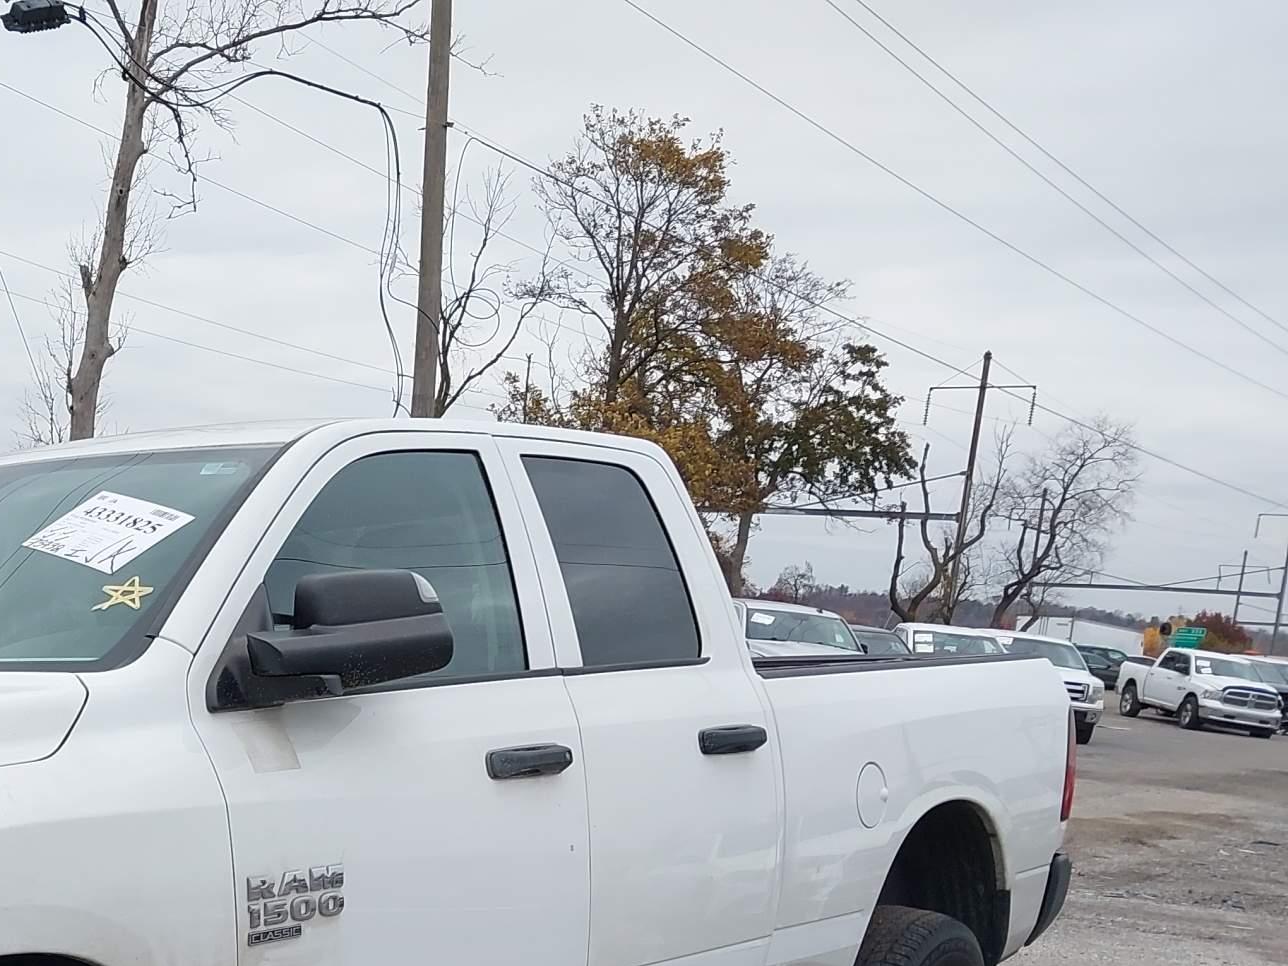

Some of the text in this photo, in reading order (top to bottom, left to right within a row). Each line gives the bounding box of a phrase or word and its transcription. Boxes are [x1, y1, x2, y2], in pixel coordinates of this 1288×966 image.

[83, 506, 164, 534] 43331825
[246, 863, 344, 902] RAM
[248, 891, 344, 929] 1500
[250, 925, 301, 945] CLASSIC
